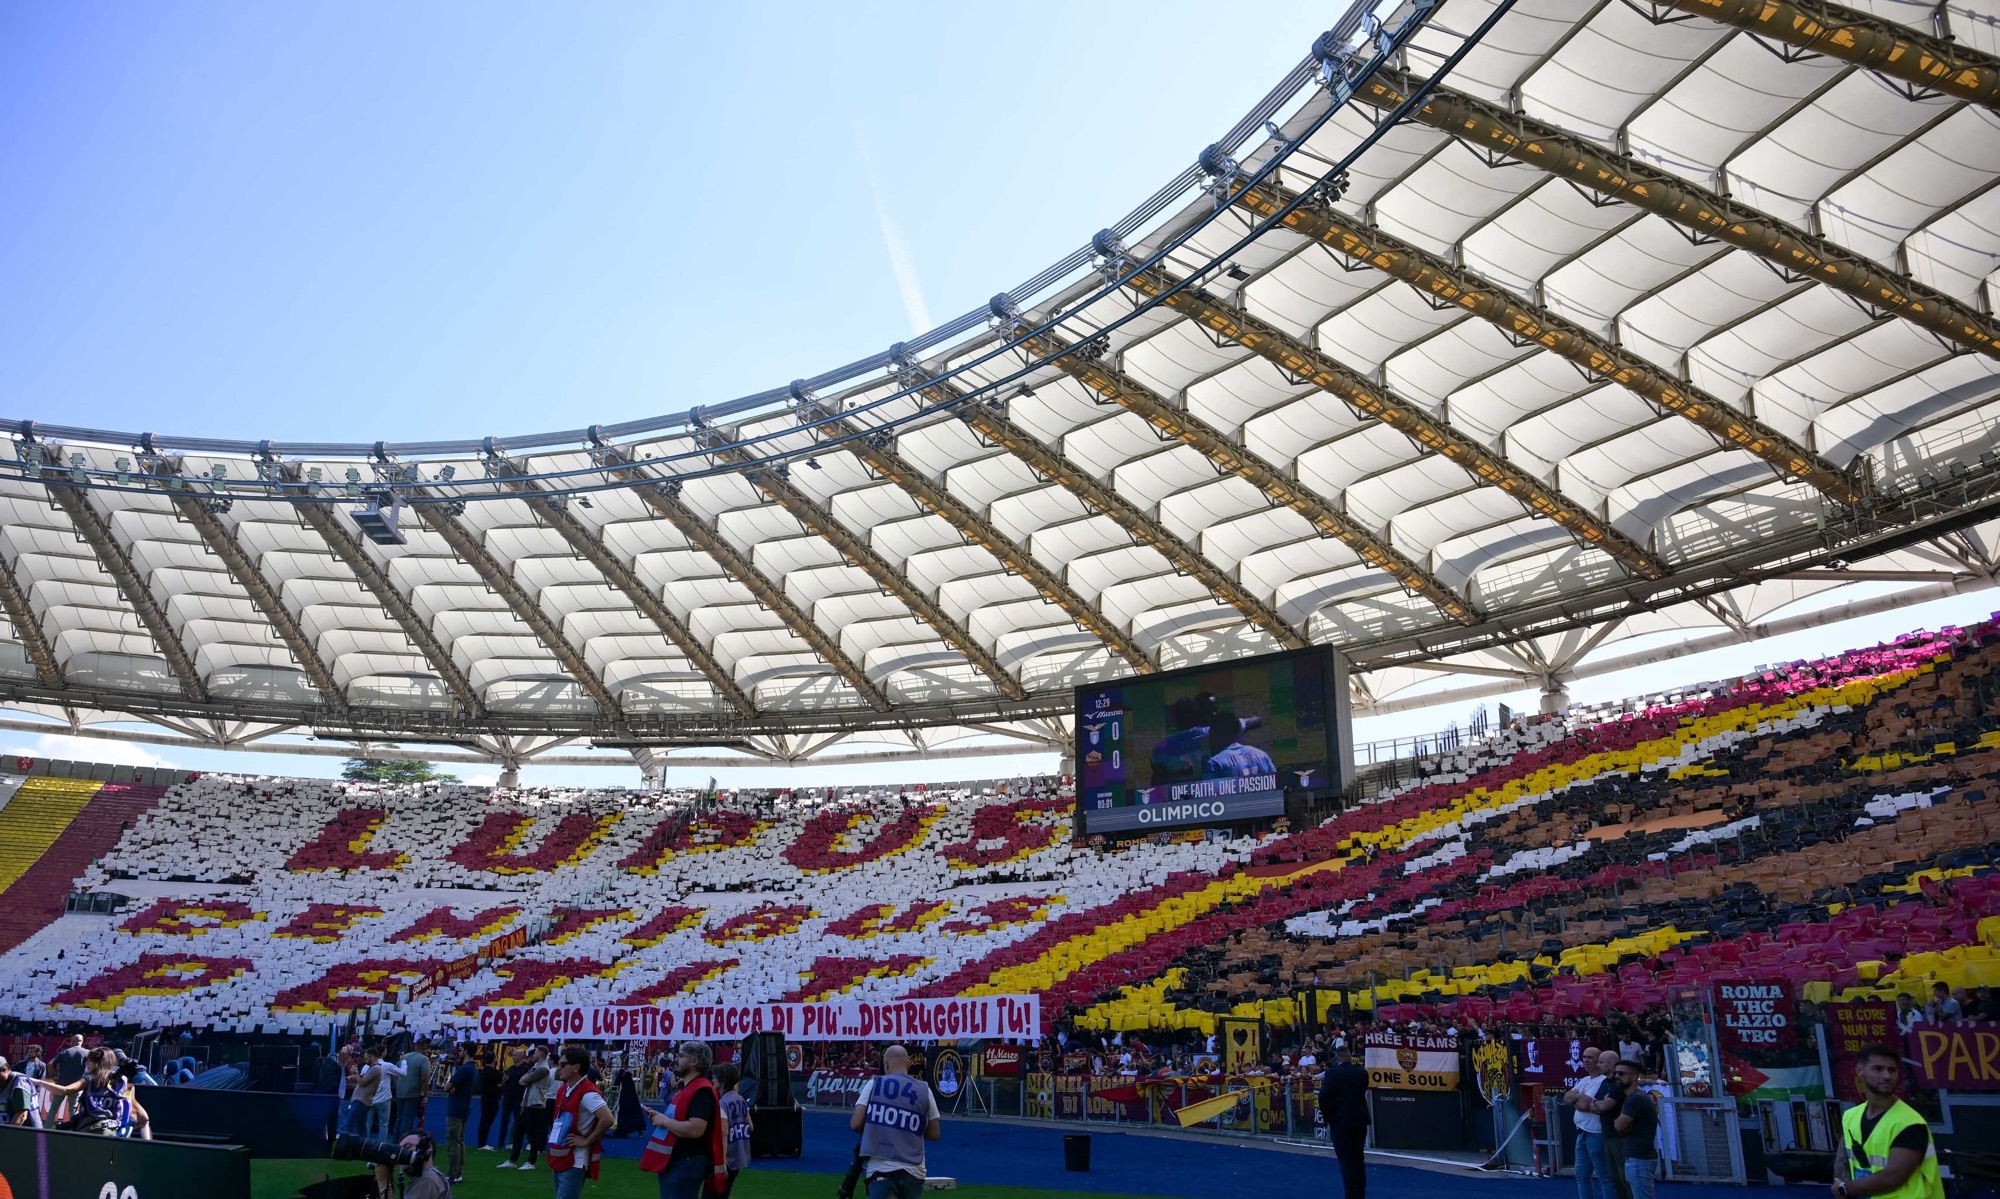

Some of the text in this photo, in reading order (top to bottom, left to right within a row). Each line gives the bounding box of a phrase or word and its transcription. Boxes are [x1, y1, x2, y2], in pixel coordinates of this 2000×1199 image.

[1112, 721, 1119, 740] 0
[1112, 750, 1120, 769] 0
[1171, 774, 1276, 801] ONE FAITH, ONE PASSION
[1138, 801, 1225, 823] OLIMPICO
[1721, 985, 1784, 999] ROMA
[1733, 1000, 1774, 1013] THC
[1837, 1008, 1887, 1021] ER CORE
[480, 1008, 584, 1034] CORAGGIO
[593, 1007, 674, 1036] LUPETTO
[683, 1006, 763, 1034] ATTACCA
[772, 1005, 793, 1032] DI
[997, 997, 1031, 1035] TU!
[1726, 1014, 1786, 1028] LAZIO
[1738, 1029, 1777, 1043] TBC
[1842, 1024, 1888, 1037] NUN SE
[1407, 1035, 1459, 1049] TEAMS
[1918, 1030, 2000, 1080] PAR
[1055, 1076, 1083, 1093] NEL
[1372, 1072, 1447, 1086] ONE SOUL
[1563, 1077, 1582, 1087] 192
[874, 1077, 917, 1105] 104
[1063, 1096, 1078, 1114] DI
[1255, 1108, 1286, 1125] OMA
